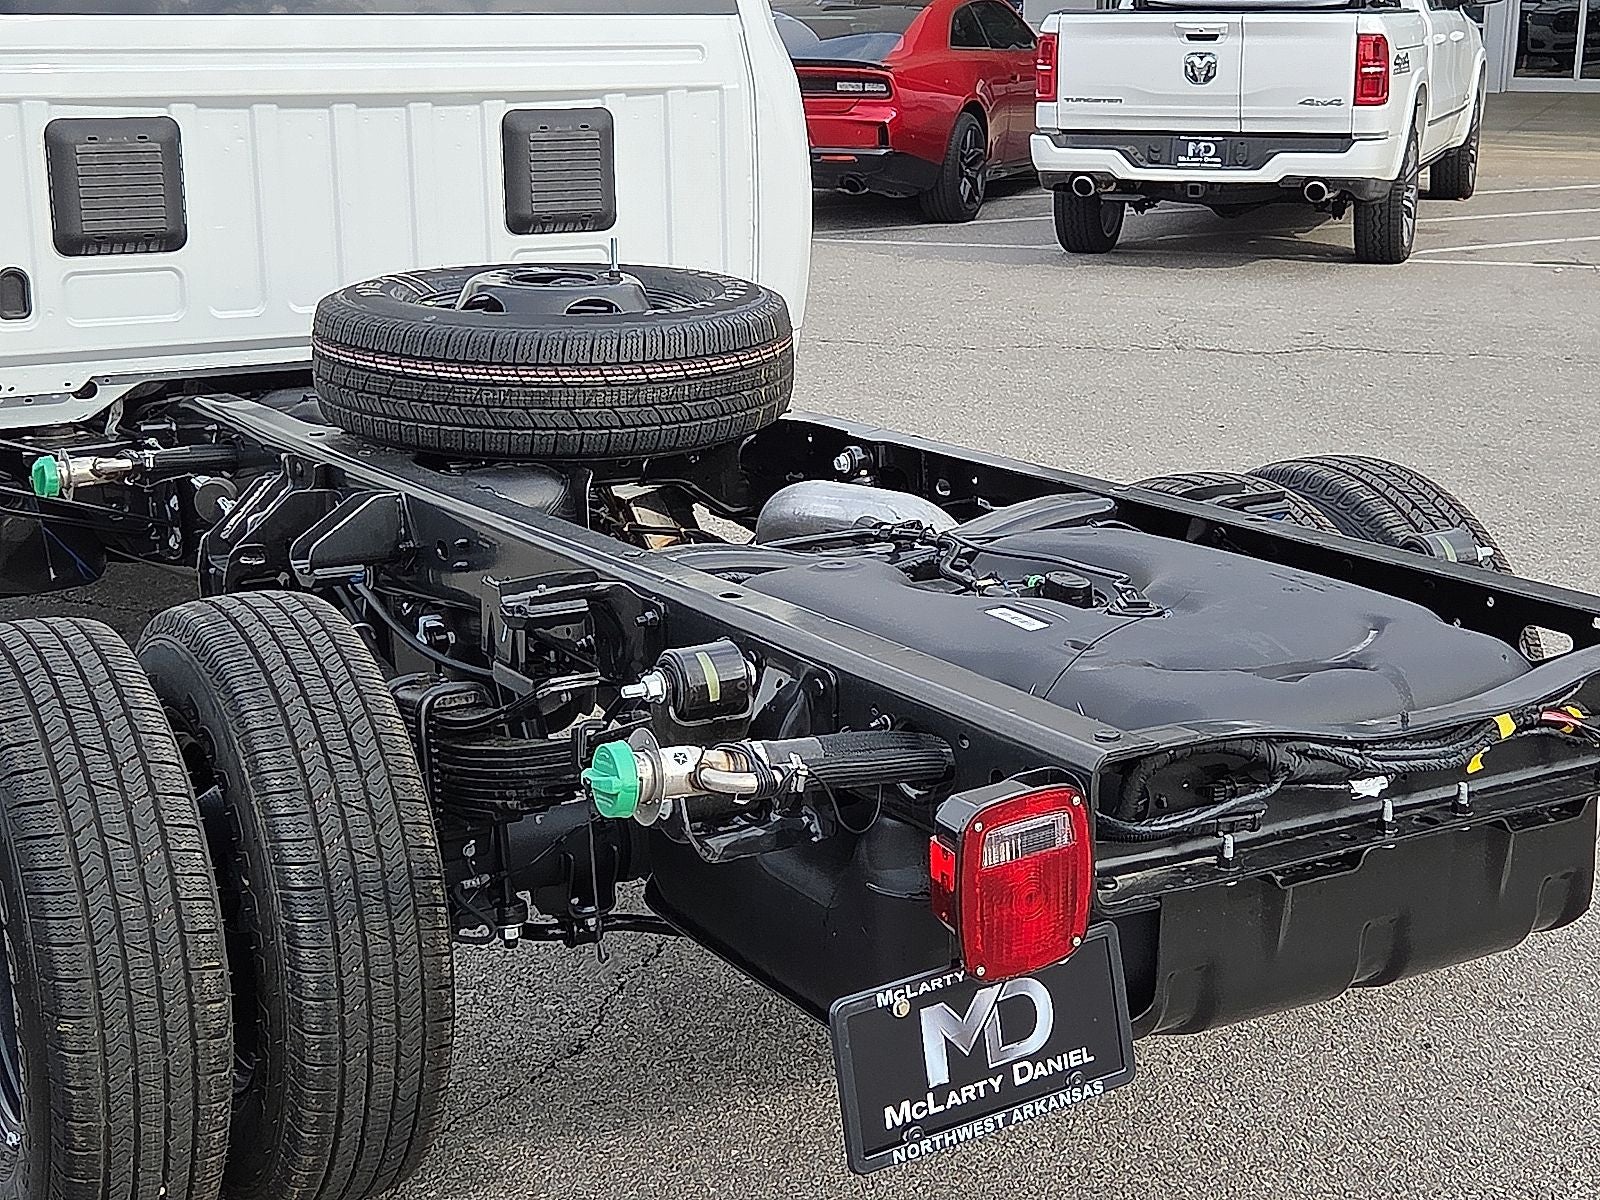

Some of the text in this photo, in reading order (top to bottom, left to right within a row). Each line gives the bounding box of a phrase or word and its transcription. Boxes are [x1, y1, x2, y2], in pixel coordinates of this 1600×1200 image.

[1187, 141, 1216, 157] MD
[919, 976, 1055, 1089] MD
[1012, 1046, 1096, 1087] DANIEL
[892, 1079, 1105, 1165] NORTHWEST ARKANSAS
